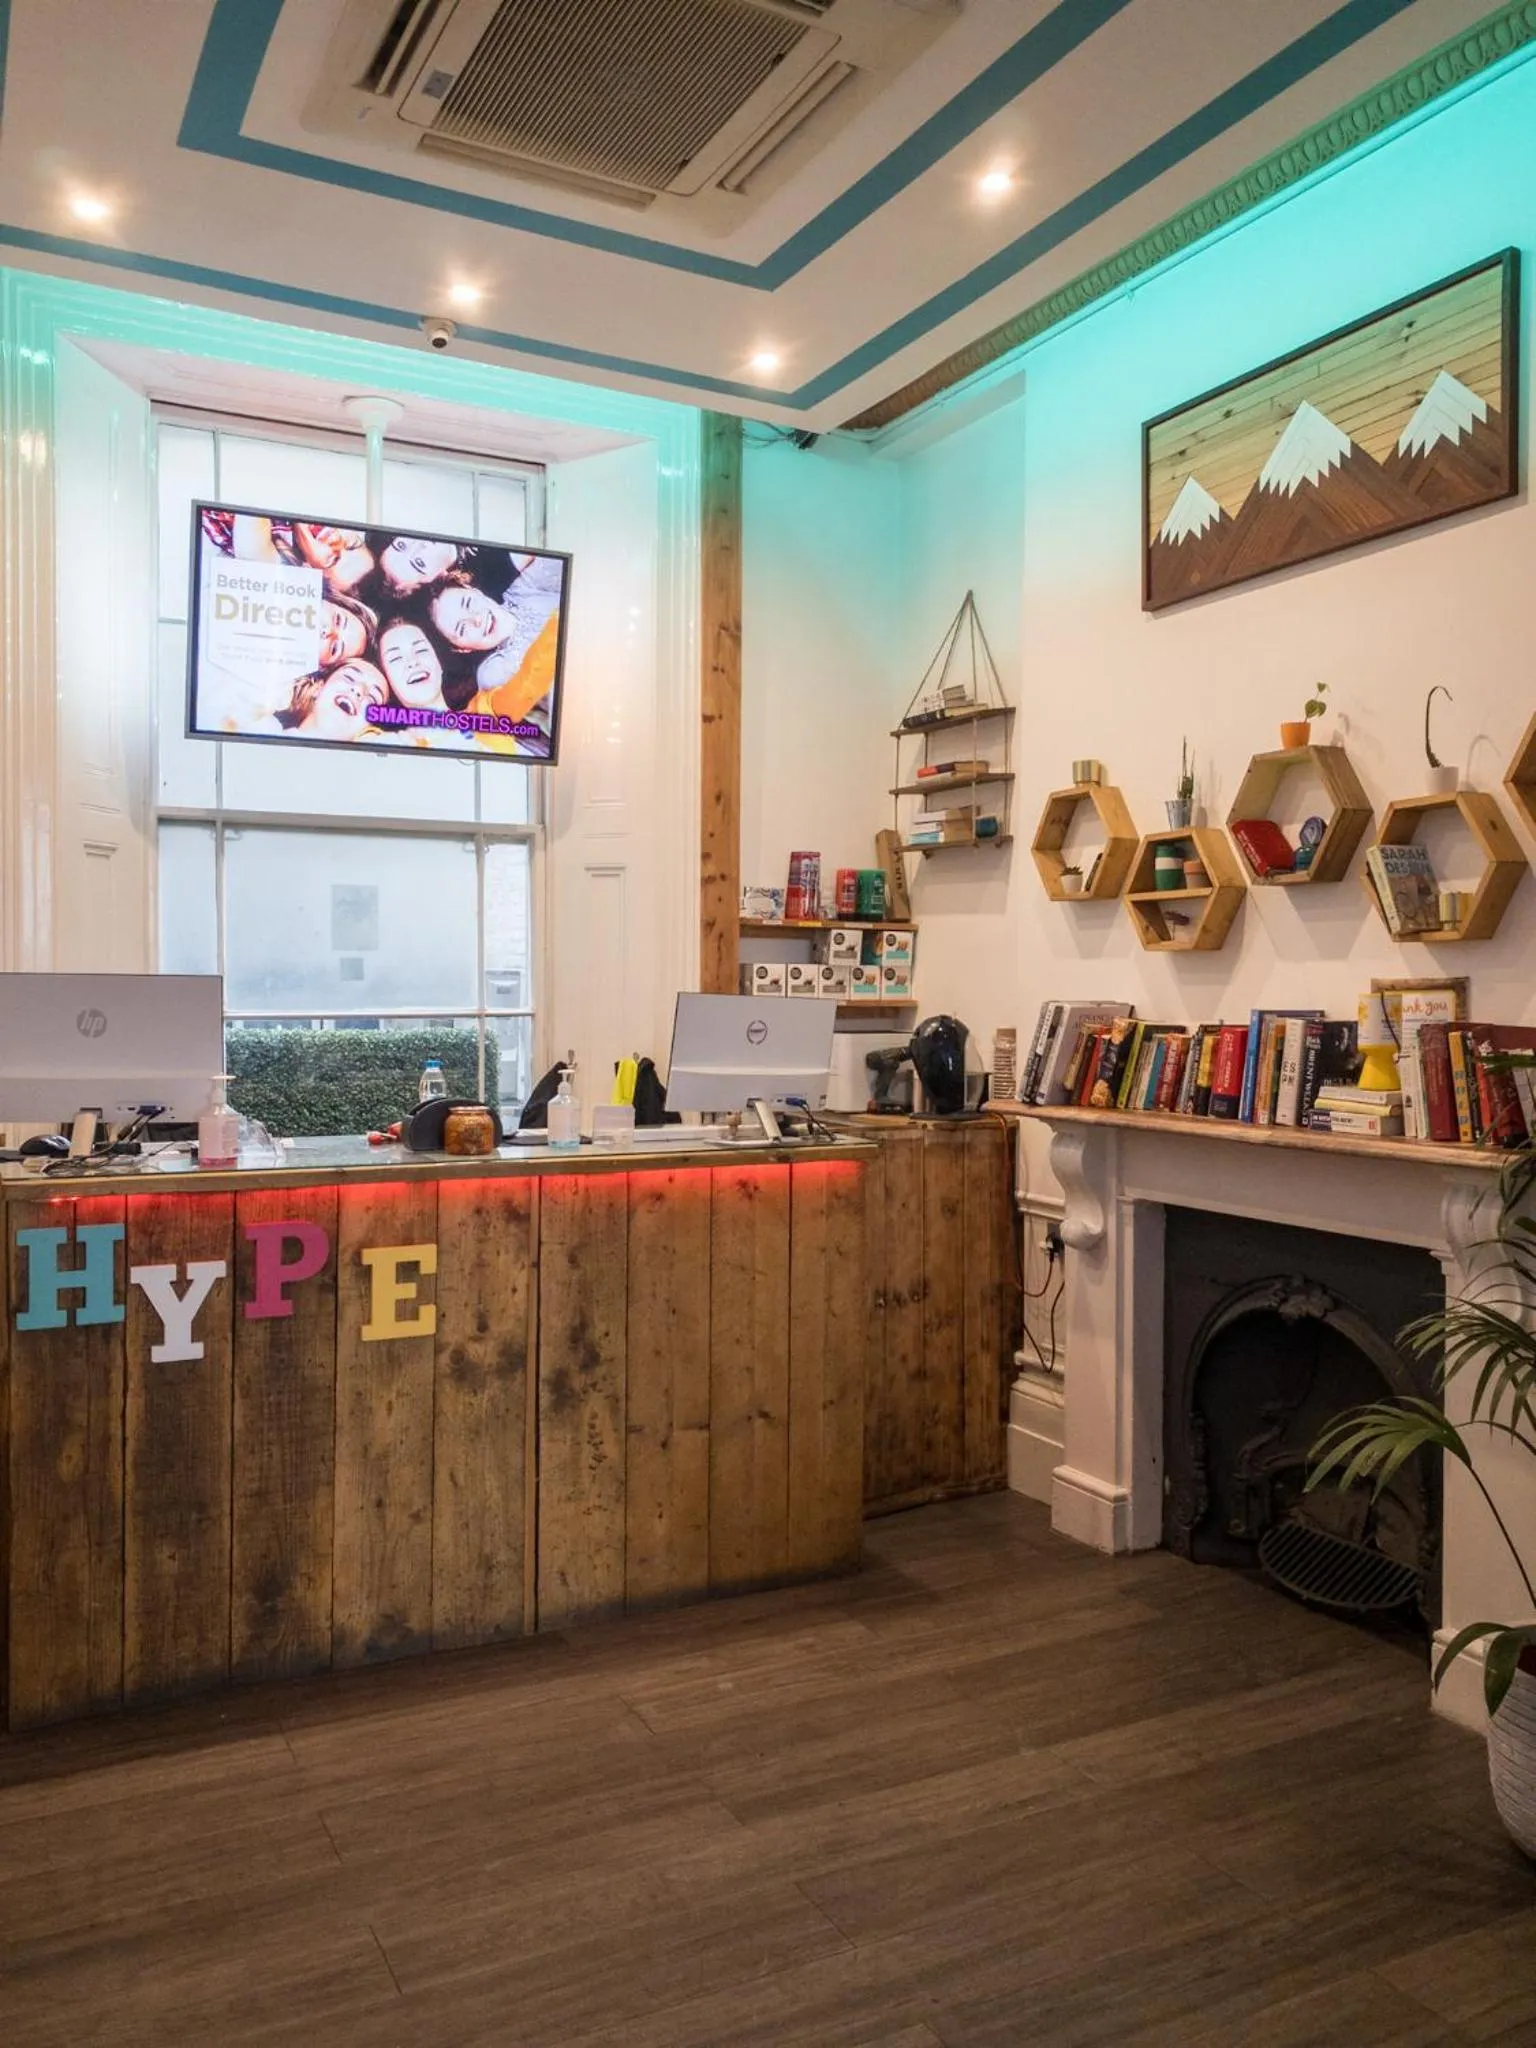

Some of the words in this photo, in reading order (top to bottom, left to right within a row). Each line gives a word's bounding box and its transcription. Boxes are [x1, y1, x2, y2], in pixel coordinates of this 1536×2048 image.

[217, 574, 268, 592] Better
[274, 581, 316, 598] Book
[215, 593, 317, 629] Direct
[367, 706, 539, 736] SMARTHOSTELS.com
[1381, 847, 1427, 860] SARAH
[77, 1008, 107, 1038] hp
[1425, 1000, 1448, 1016] you
[16, 1220, 437, 1362] HYPE
